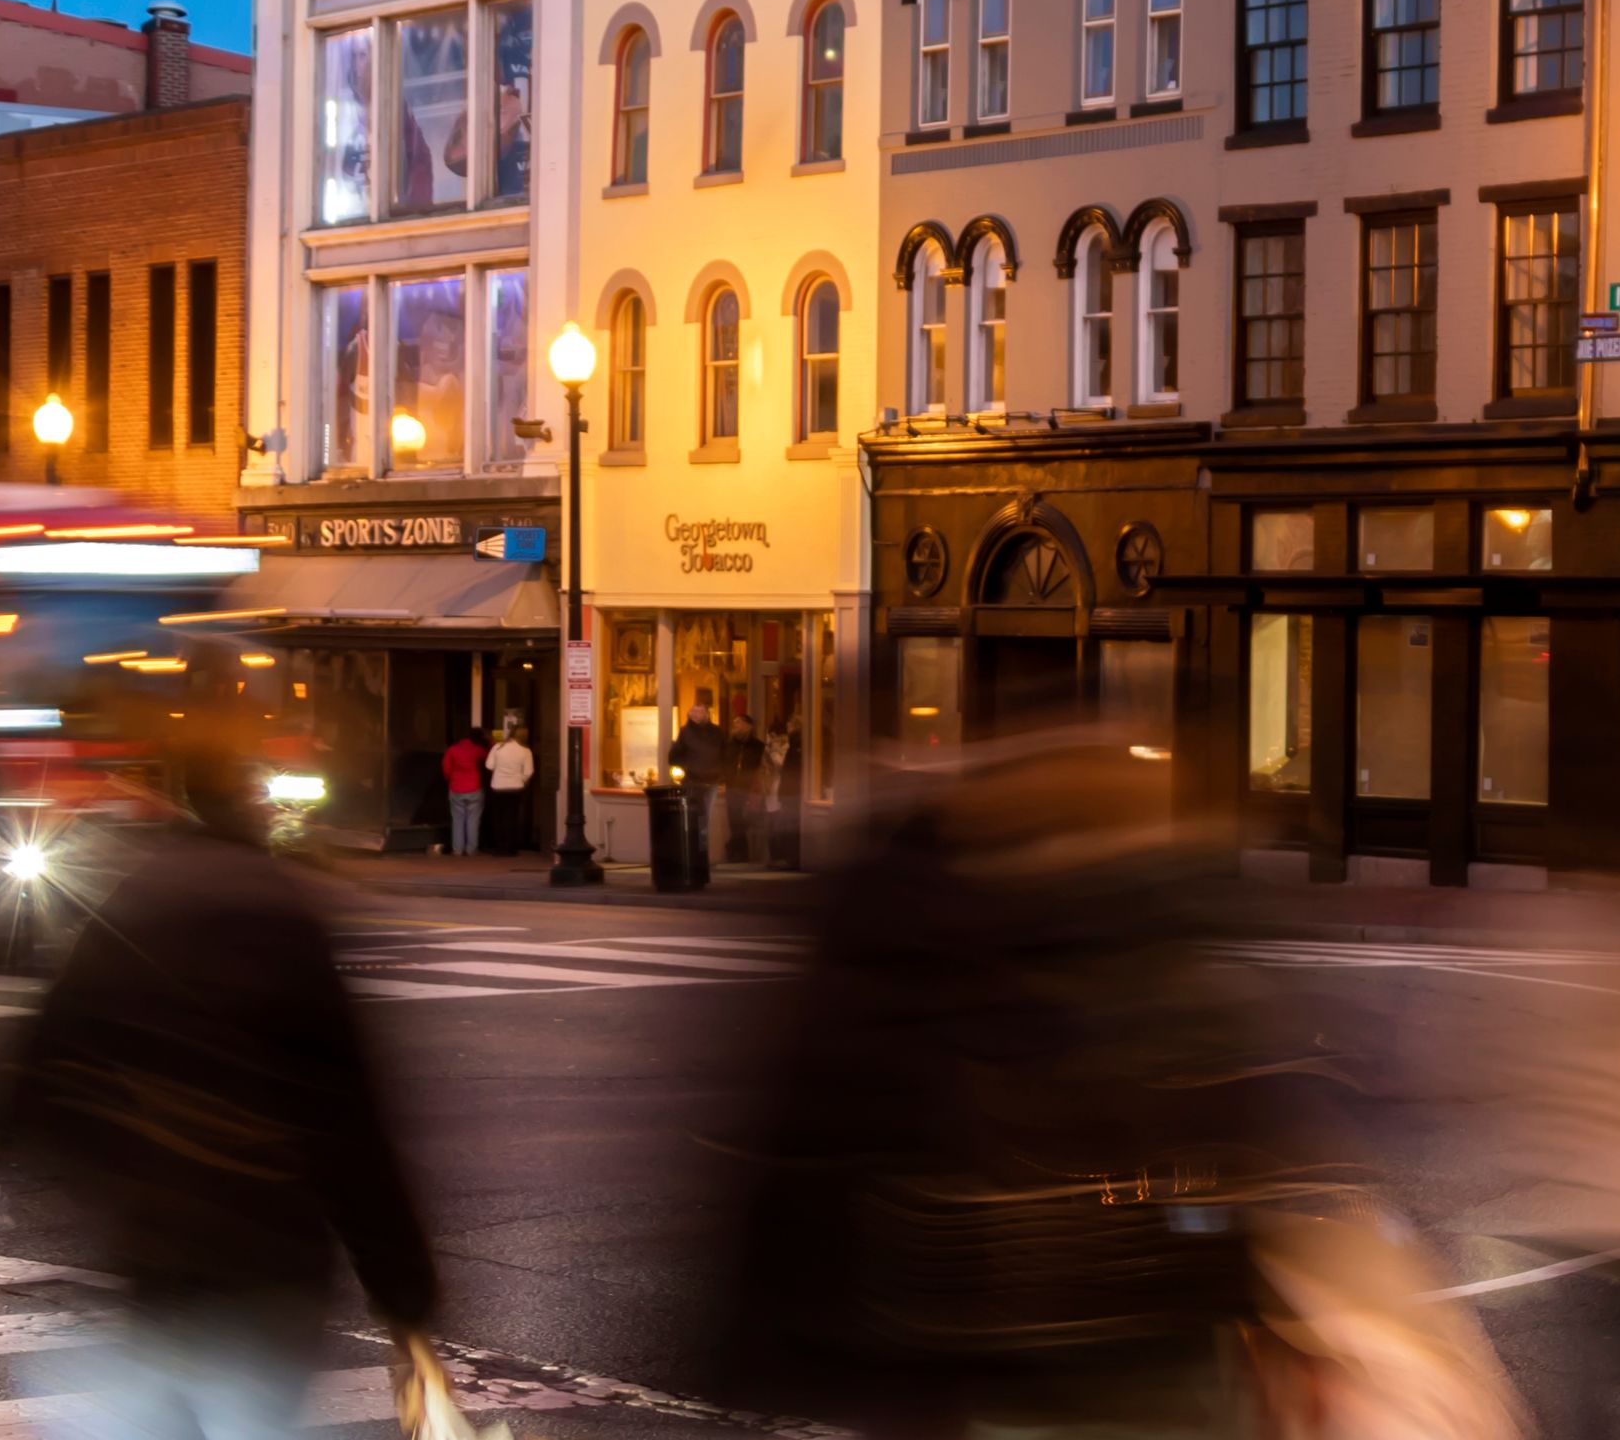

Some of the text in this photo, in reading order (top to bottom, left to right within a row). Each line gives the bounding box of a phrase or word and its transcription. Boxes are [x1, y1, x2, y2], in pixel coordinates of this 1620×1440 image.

[320, 518, 397, 547] SPORTS
[400, 517, 456, 545] ZONE
[665, 513, 771, 548] Georgetown
